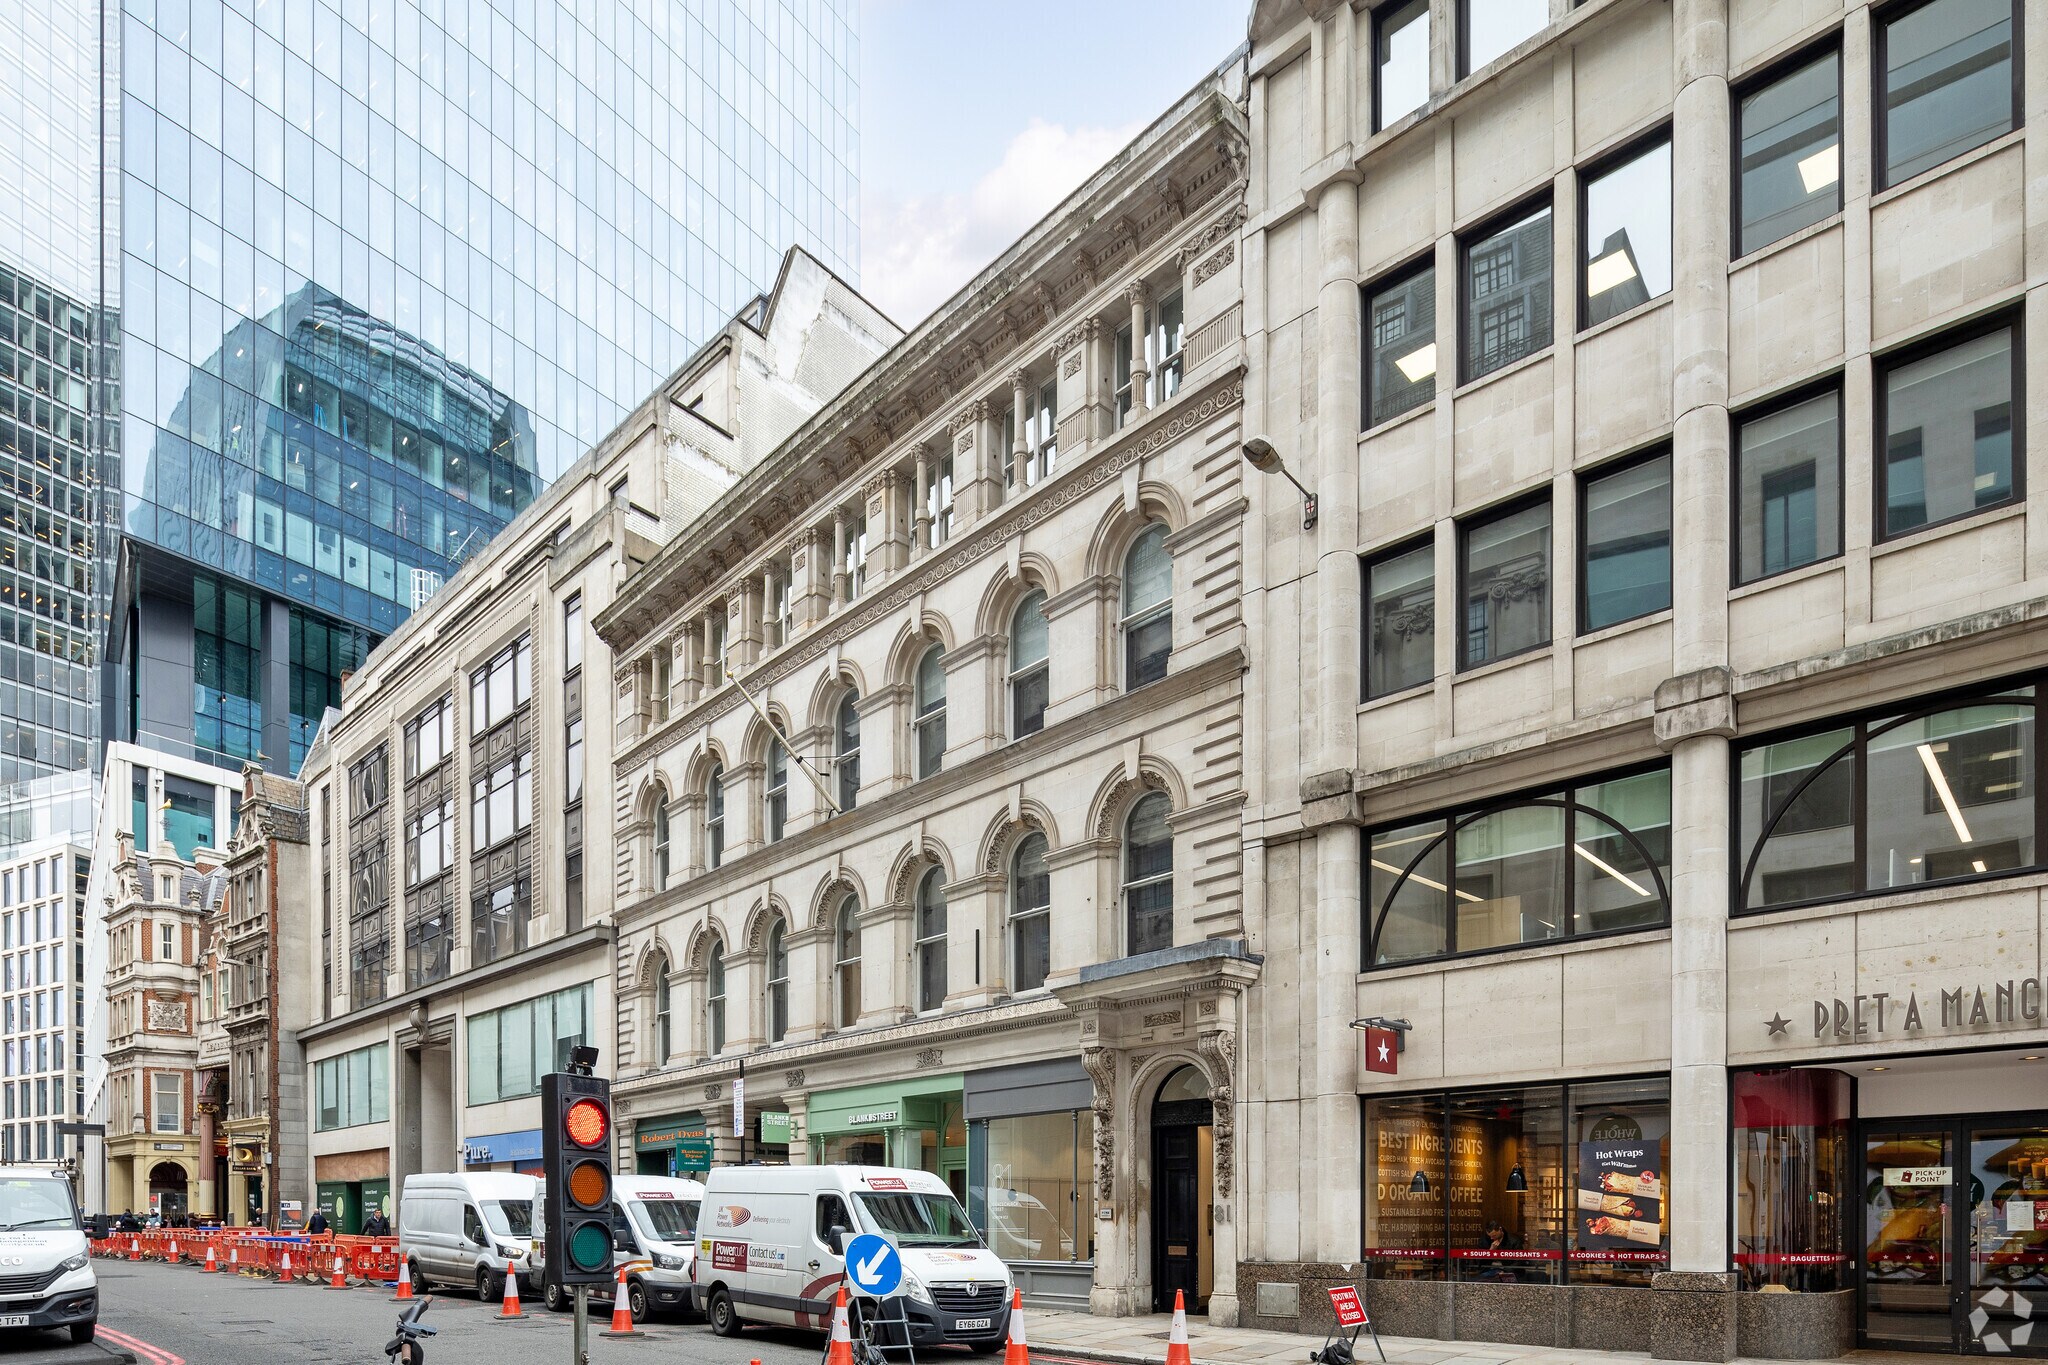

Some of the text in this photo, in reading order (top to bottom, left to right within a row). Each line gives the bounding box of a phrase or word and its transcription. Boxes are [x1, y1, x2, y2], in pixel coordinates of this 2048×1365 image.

[1814, 977, 2048, 1038] PRET A MANG
[848, 1111, 898, 1124] BLANK STREET
[640, 1133, 676, 1144] Robert
[1380, 1130, 1410, 1150] BEST
[464, 1142, 494, 1160] Pure.
[1596, 1149, 1644, 1160] Hot Wraps
[1409, 1156, 1424, 1164] FRESH
[992, 1164, 1012, 1190] 81
[1444, 1186, 1483, 1202] OFFEE
[1382, 1208, 1420, 1216] SUSTAINABLE
[1421, 1208, 1433, 1217] AND
[1391, 1224, 1433, 1232] HARDWORKING
[1434, 1224, 1460, 1232] BARTAS
[716, 1242, 746, 1257] Powercut?
[749, 1246, 777, 1260] Contact us!
[1331, 1292, 1355, 1302] FOOTWAY
[1340, 1302, 1356, 1310] AHEAD
[5, 1316, 25, 1326] TFV
[1342, 1311, 1360, 1321] CLOSED
